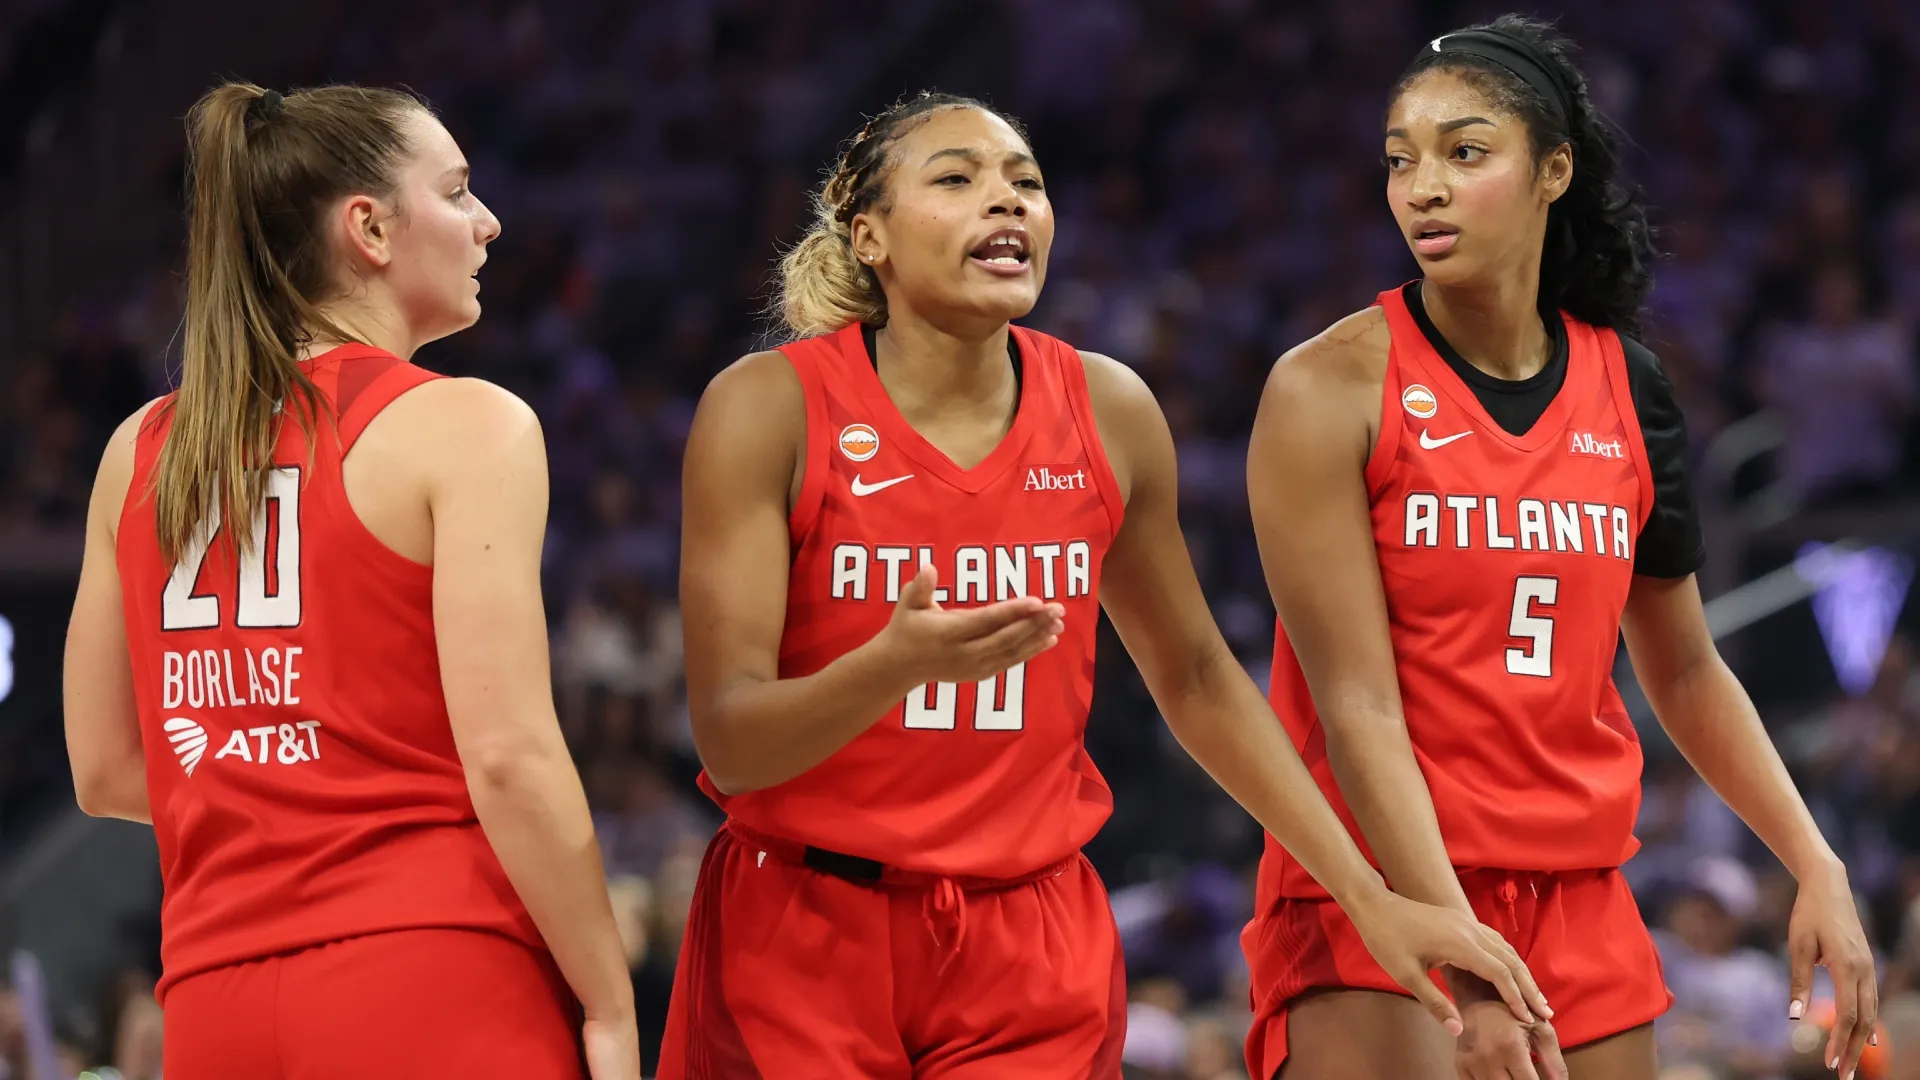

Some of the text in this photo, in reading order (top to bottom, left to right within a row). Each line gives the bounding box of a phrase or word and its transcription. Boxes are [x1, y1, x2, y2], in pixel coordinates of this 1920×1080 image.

[1571, 432, 1624, 458] Albert
[1024, 467, 1087, 490] Albert
[161, 466, 302, 632] 20
[1404, 493, 1631, 560] ATLANTA
[1505, 575, 1559, 677] 5
[163, 647, 303, 709] BORLASE
[215, 720, 322, 765] AT&T
